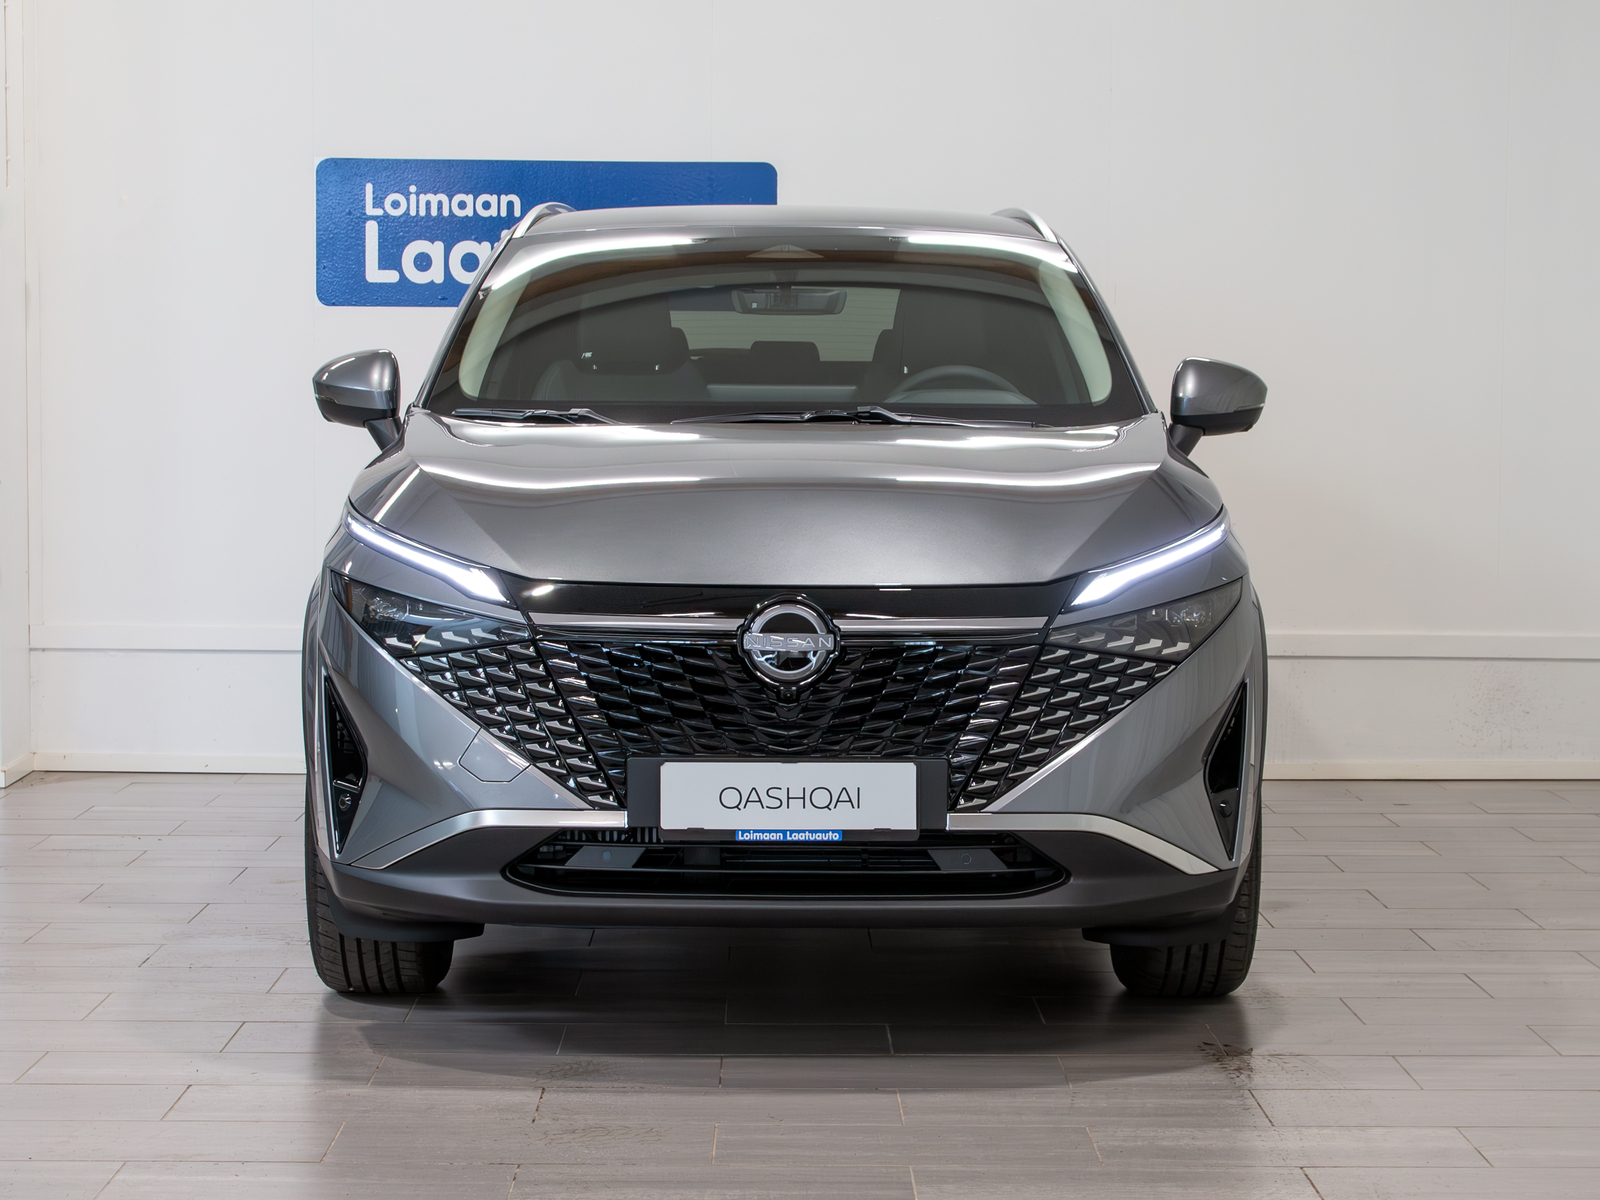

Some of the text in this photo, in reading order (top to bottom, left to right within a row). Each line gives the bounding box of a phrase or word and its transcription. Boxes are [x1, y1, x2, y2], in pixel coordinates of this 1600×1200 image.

[365, 182, 521, 217] Loimaan
[365, 220, 509, 284] Laa
[746, 637, 832, 648] NISSAN
[719, 787, 861, 811] QASHQAI
[738, 830, 840, 840] Loimaan Laatuauto
